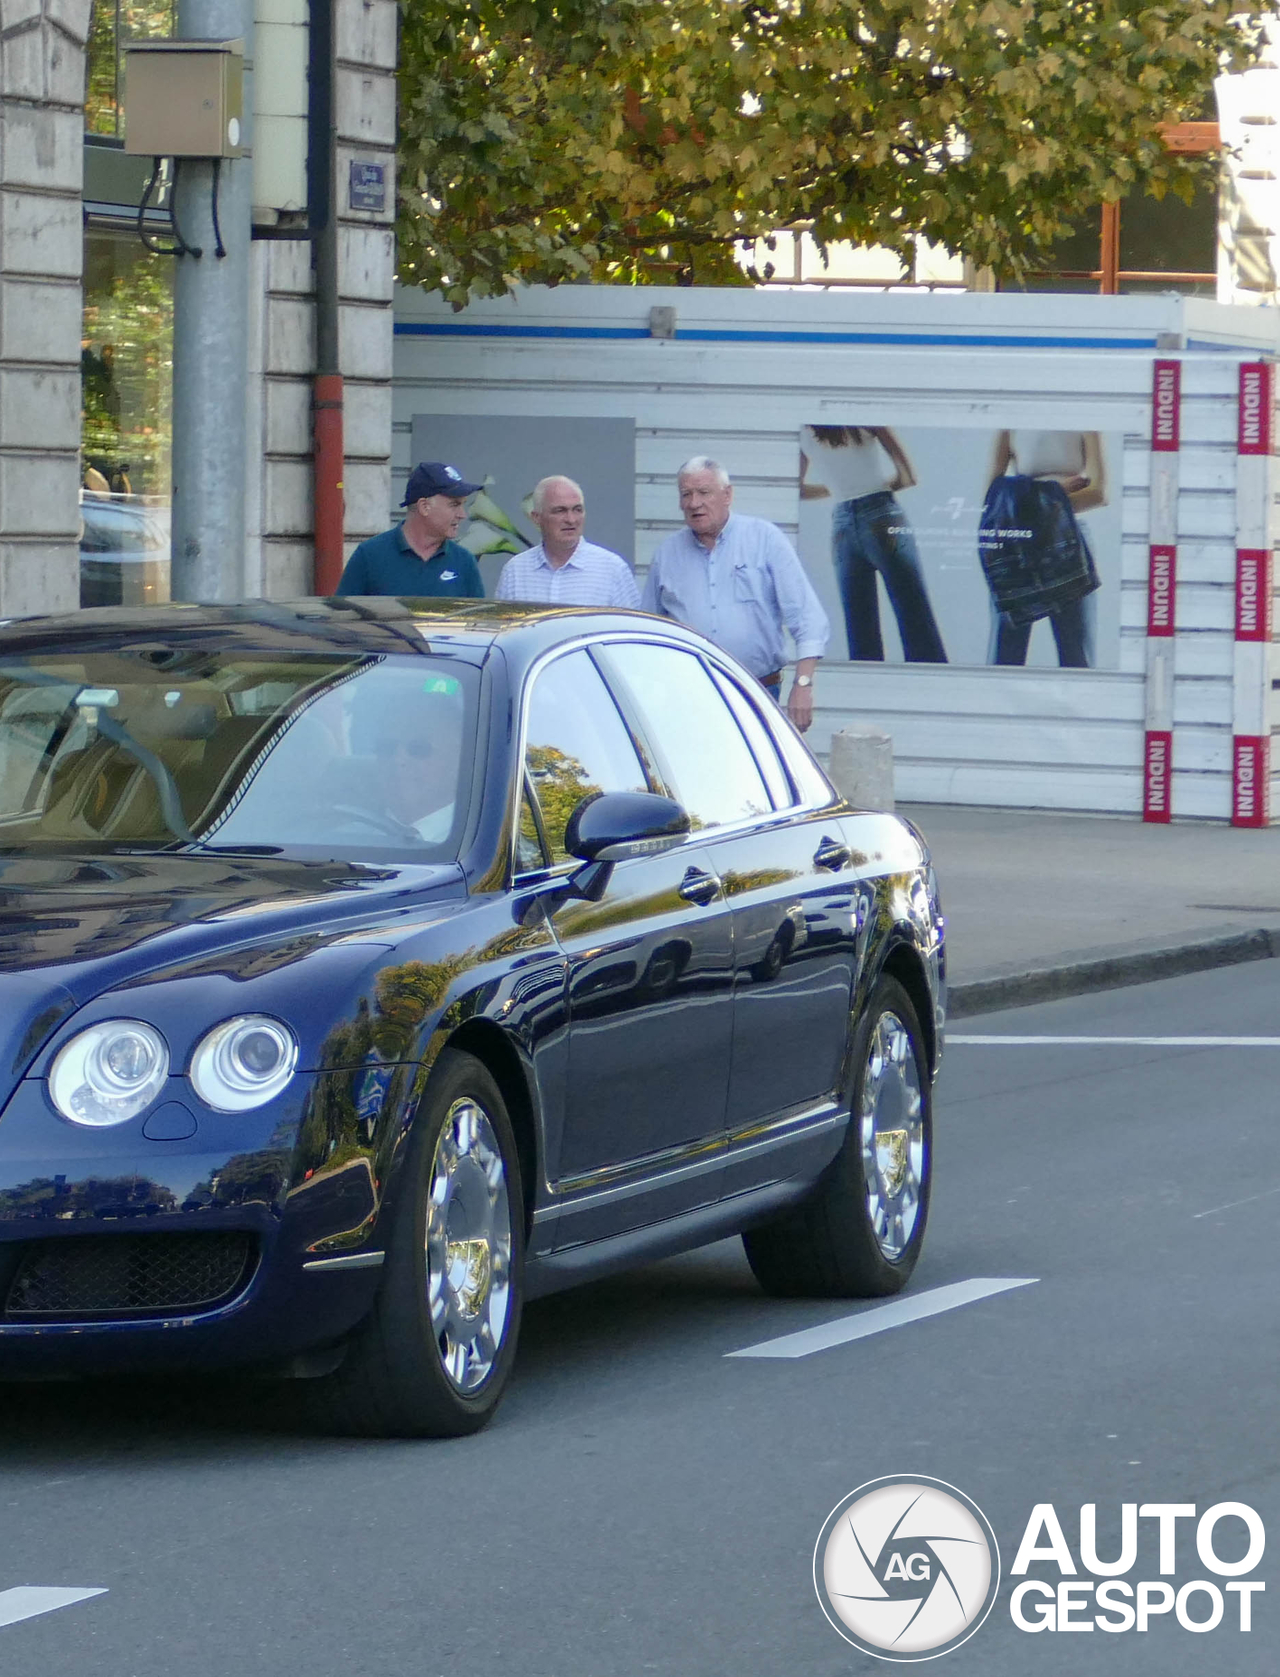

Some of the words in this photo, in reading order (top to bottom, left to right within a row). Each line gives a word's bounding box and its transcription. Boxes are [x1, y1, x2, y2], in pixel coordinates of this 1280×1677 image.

[1157, 369, 1174, 441] INDUNI
[1243, 372, 1260, 444] INDUNI
[998, 529, 1033, 538] WORKS
[1153, 555, 1170, 626] INDUNI
[1240, 560, 1257, 631] INDUNI
[1148, 740, 1166, 812] INDUNI
[1237, 746, 1254, 817] INDUNI
